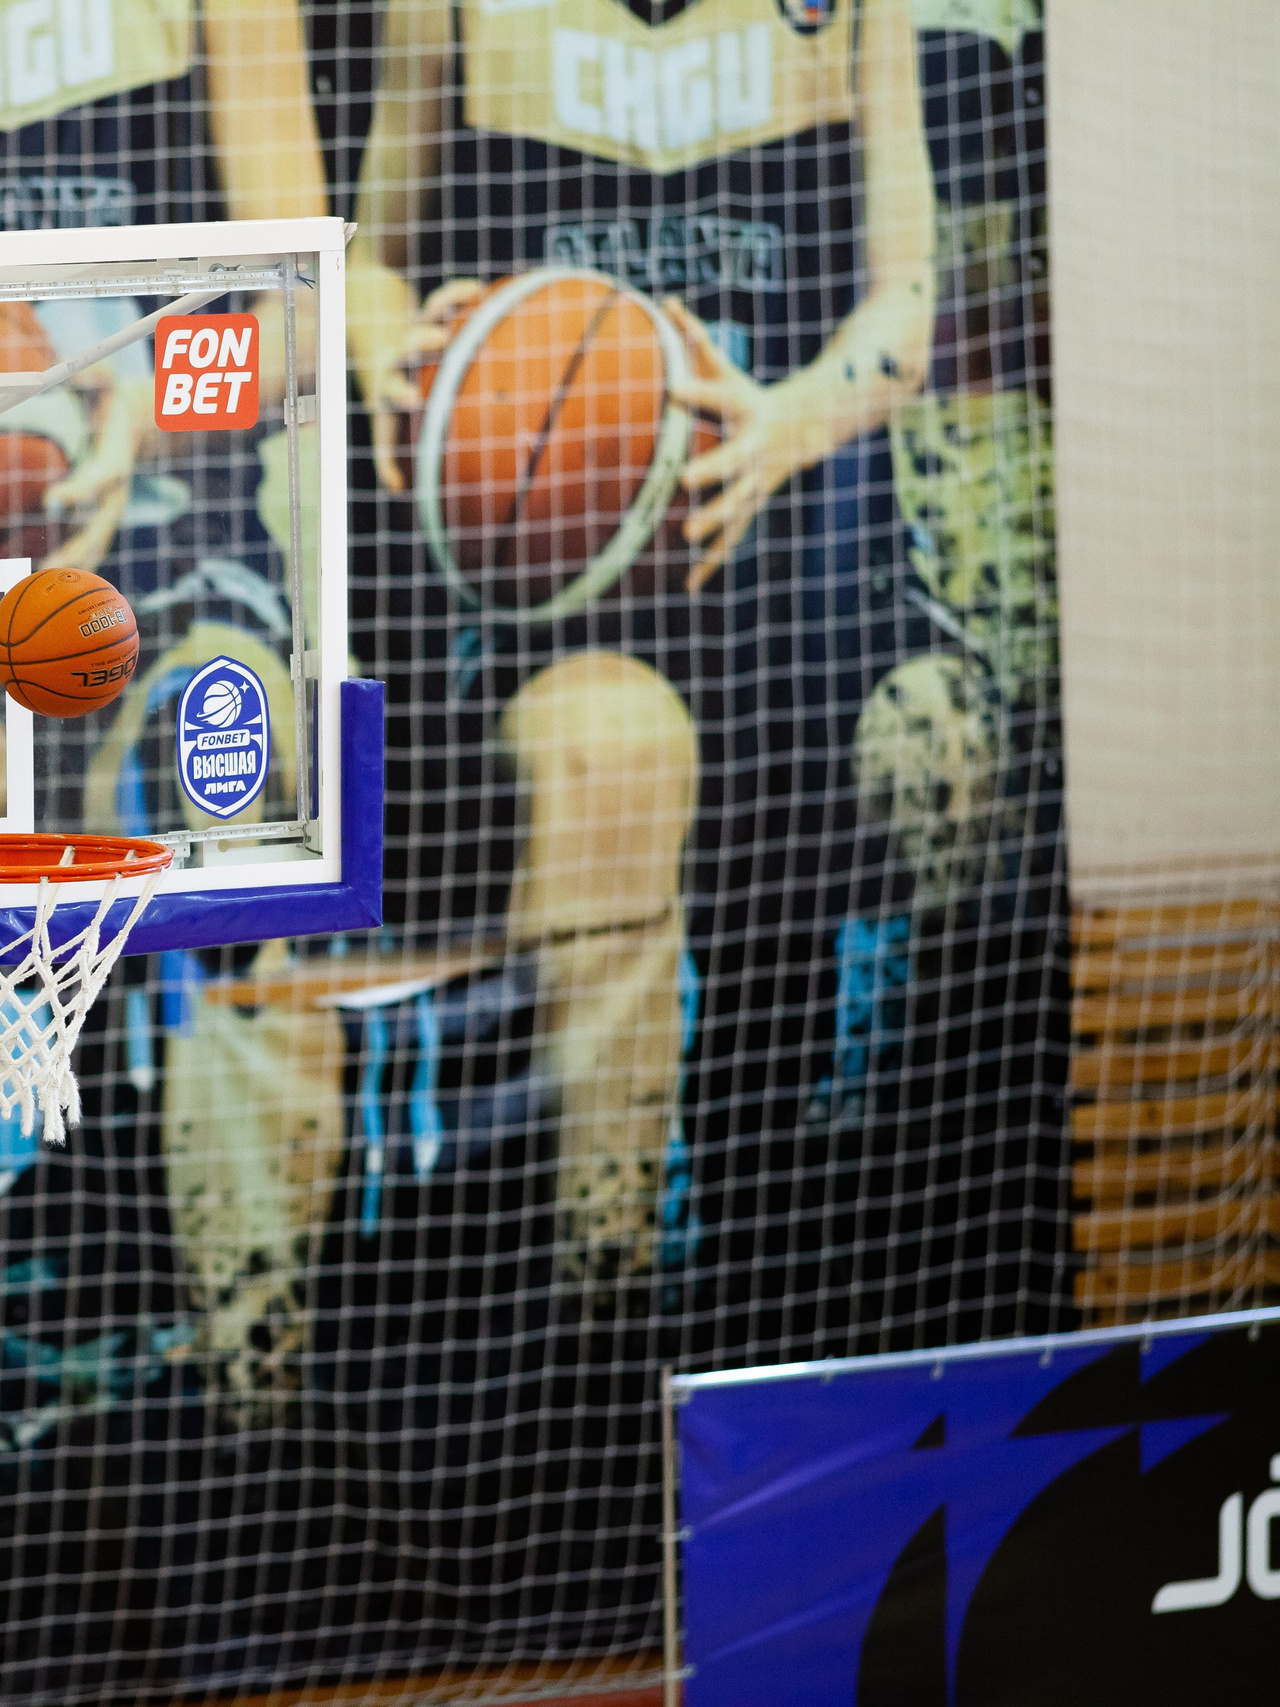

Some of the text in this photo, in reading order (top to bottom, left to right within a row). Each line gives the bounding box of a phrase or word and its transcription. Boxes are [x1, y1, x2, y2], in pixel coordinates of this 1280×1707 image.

[554, 22, 772, 153] CHGU
[162, 327, 253, 369] FON
[161, 371, 253, 416] BET
[201, 732, 246, 746] FONBET
[193, 750, 256, 779] ВЫСШАЯ
[204, 780, 247, 796] ЛИГА
